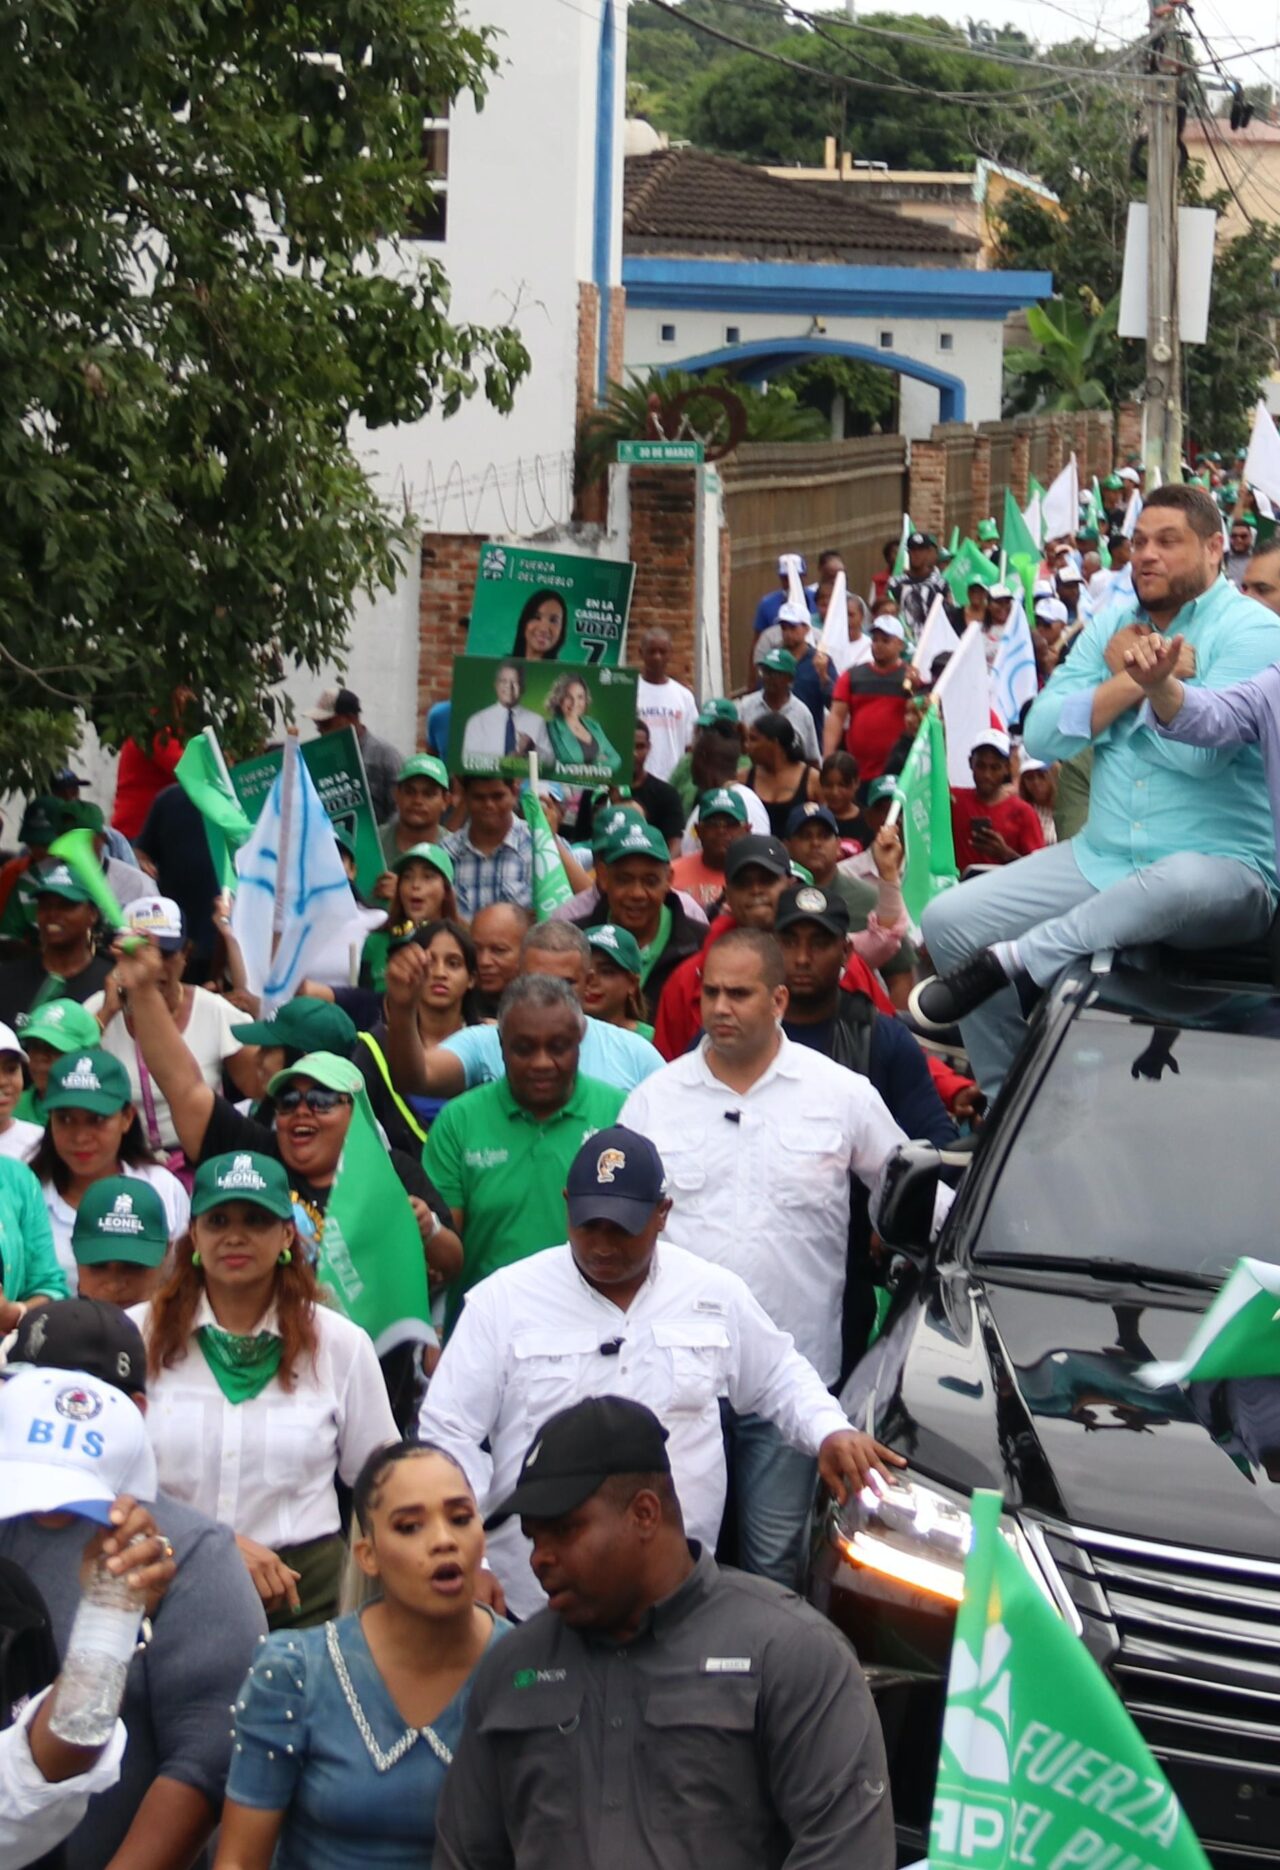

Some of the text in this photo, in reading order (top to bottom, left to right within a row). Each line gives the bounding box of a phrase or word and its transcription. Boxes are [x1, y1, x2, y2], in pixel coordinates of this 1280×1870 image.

[639, 446, 696, 459] 30 DE MARZO
[519, 559, 556, 573] FUERZA
[516, 572, 574, 588] DEL PUEBLO
[585, 598, 615, 611] EN LA
[574, 609, 613, 623] CASILLA
[575, 622, 619, 639] VOTA
[581, 638, 608, 665] 7
[555, 759, 613, 779] Ivannia
[318, 770, 350, 789] EN LA
[218, 1173, 267, 1188] LEONEL
[98, 1216, 145, 1232] LEONEL
[27, 1417, 105, 1458] BIS
[1012, 1719, 1179, 1850] FUERZA
